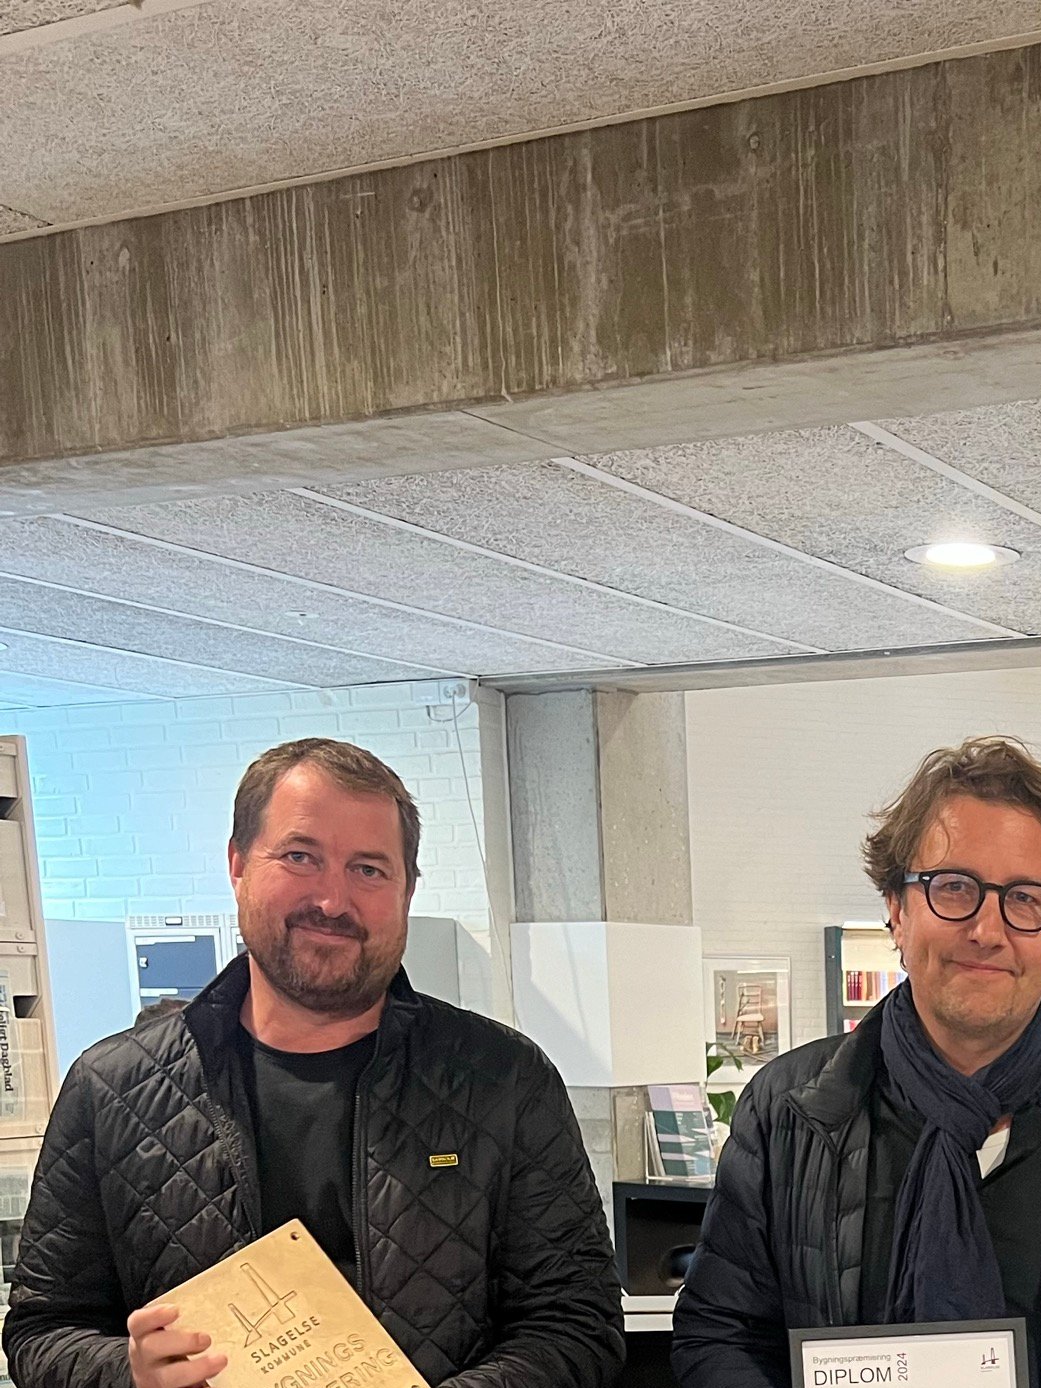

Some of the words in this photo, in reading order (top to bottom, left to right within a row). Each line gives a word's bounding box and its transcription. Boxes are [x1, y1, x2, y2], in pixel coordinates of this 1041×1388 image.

[0, 1043, 13, 1091] Dagblad
[251, 1316, 321, 1363] SLAGELSE
[261, 1340, 312, 1374] KOMMUNE
[813, 1354, 891, 1365] Bygningspræmiering
[897, 1353, 908, 1381] 2024
[814, 1367, 892, 1385] DIPLOM
